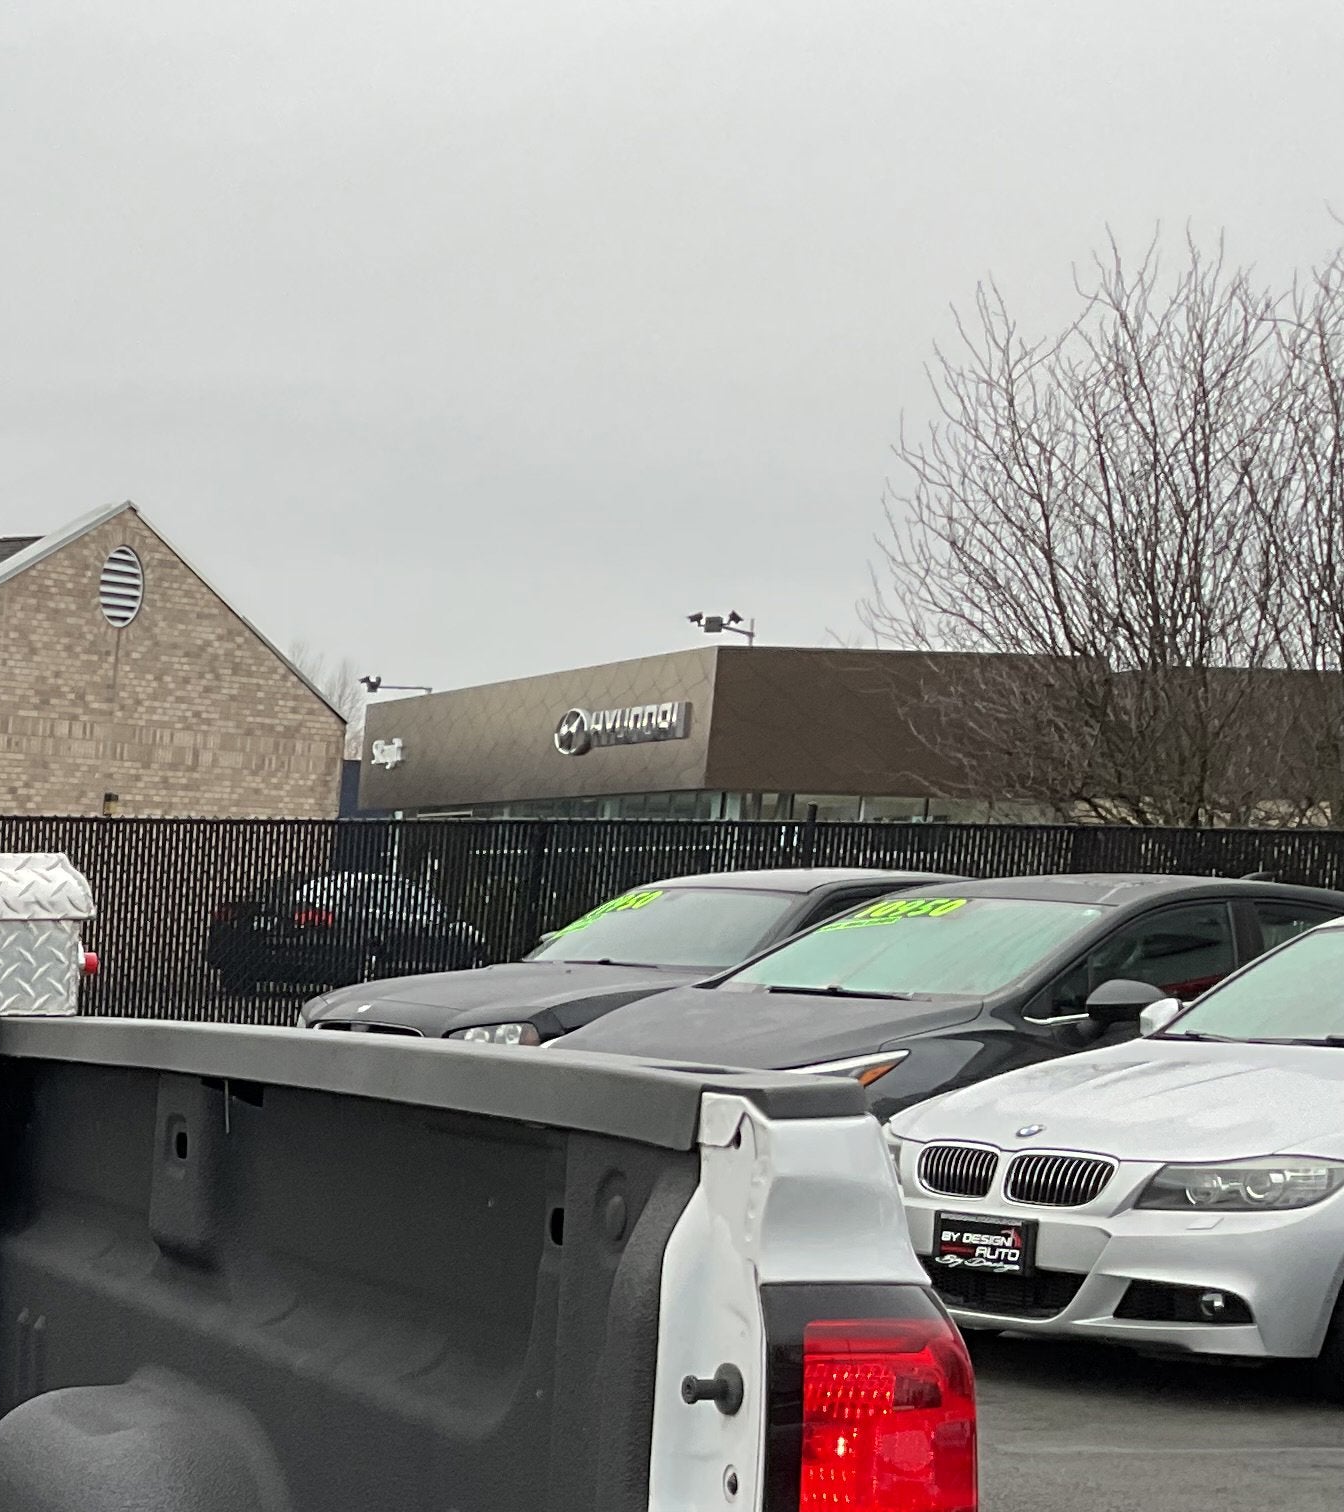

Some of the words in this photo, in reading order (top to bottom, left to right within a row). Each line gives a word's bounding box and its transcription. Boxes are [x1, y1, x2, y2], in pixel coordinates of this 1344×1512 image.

[590, 702, 684, 747] HYUNDAI
[941, 1230, 961, 1242] BY
[962, 1232, 1013, 1247] DESIGN
[975, 1246, 1020, 1261] AUTO
